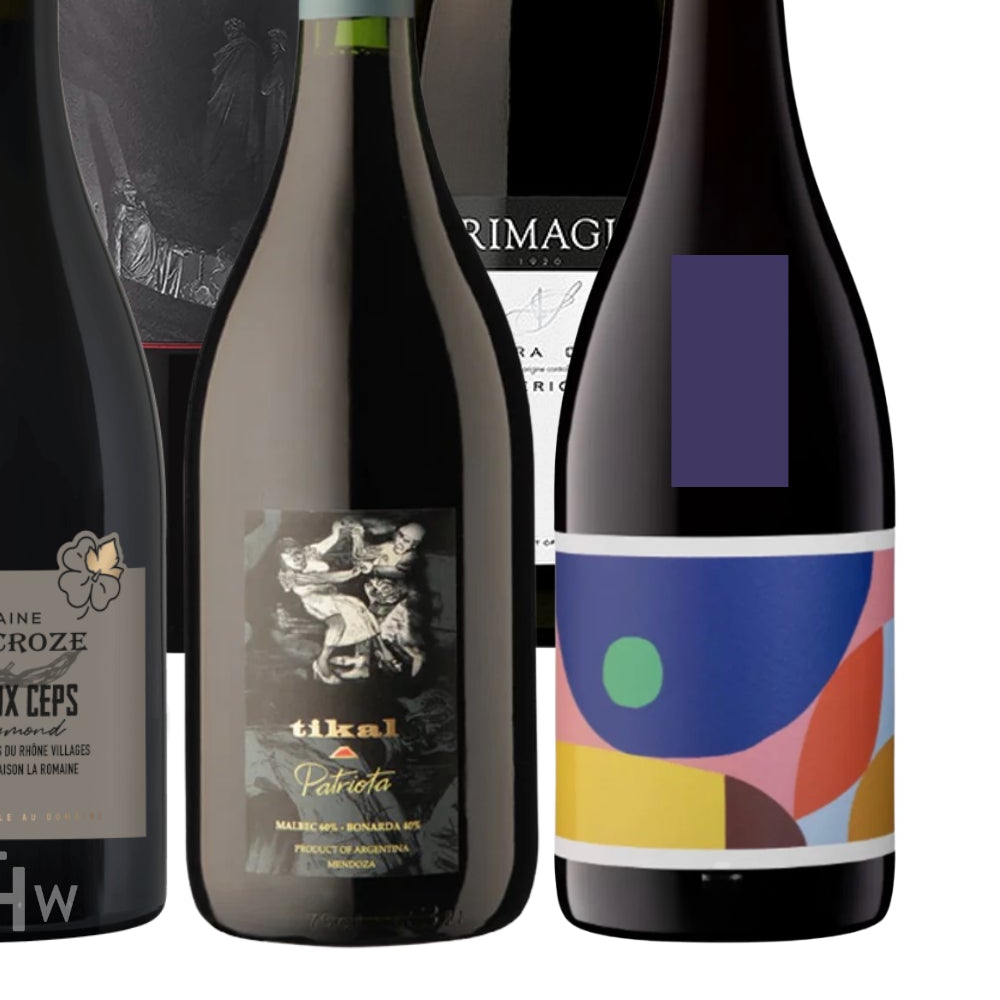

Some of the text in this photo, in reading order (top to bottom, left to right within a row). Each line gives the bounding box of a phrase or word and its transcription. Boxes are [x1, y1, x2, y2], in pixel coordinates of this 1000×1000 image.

[519, 258, 562, 266] 1920
[27, 684, 78, 717] CEPS
[289, 718, 399, 738] tikal
[5, 744, 17, 757] DU
[19, 743, 48, 757] RHÔNE
[51, 744, 91, 757] VILLAGES
[27, 763, 38, 775] LA
[40, 763, 79, 775] ROMAINE
[294, 762, 396, 797] Patriota
[22, 813, 37, 822] AU
[275, 820, 317, 832] MALBEC
[346, 821, 400, 832] BONARDA
[294, 844, 410, 854] PRODUCT OF ARGENTINA
[327, 859, 376, 869] MENDOZA
